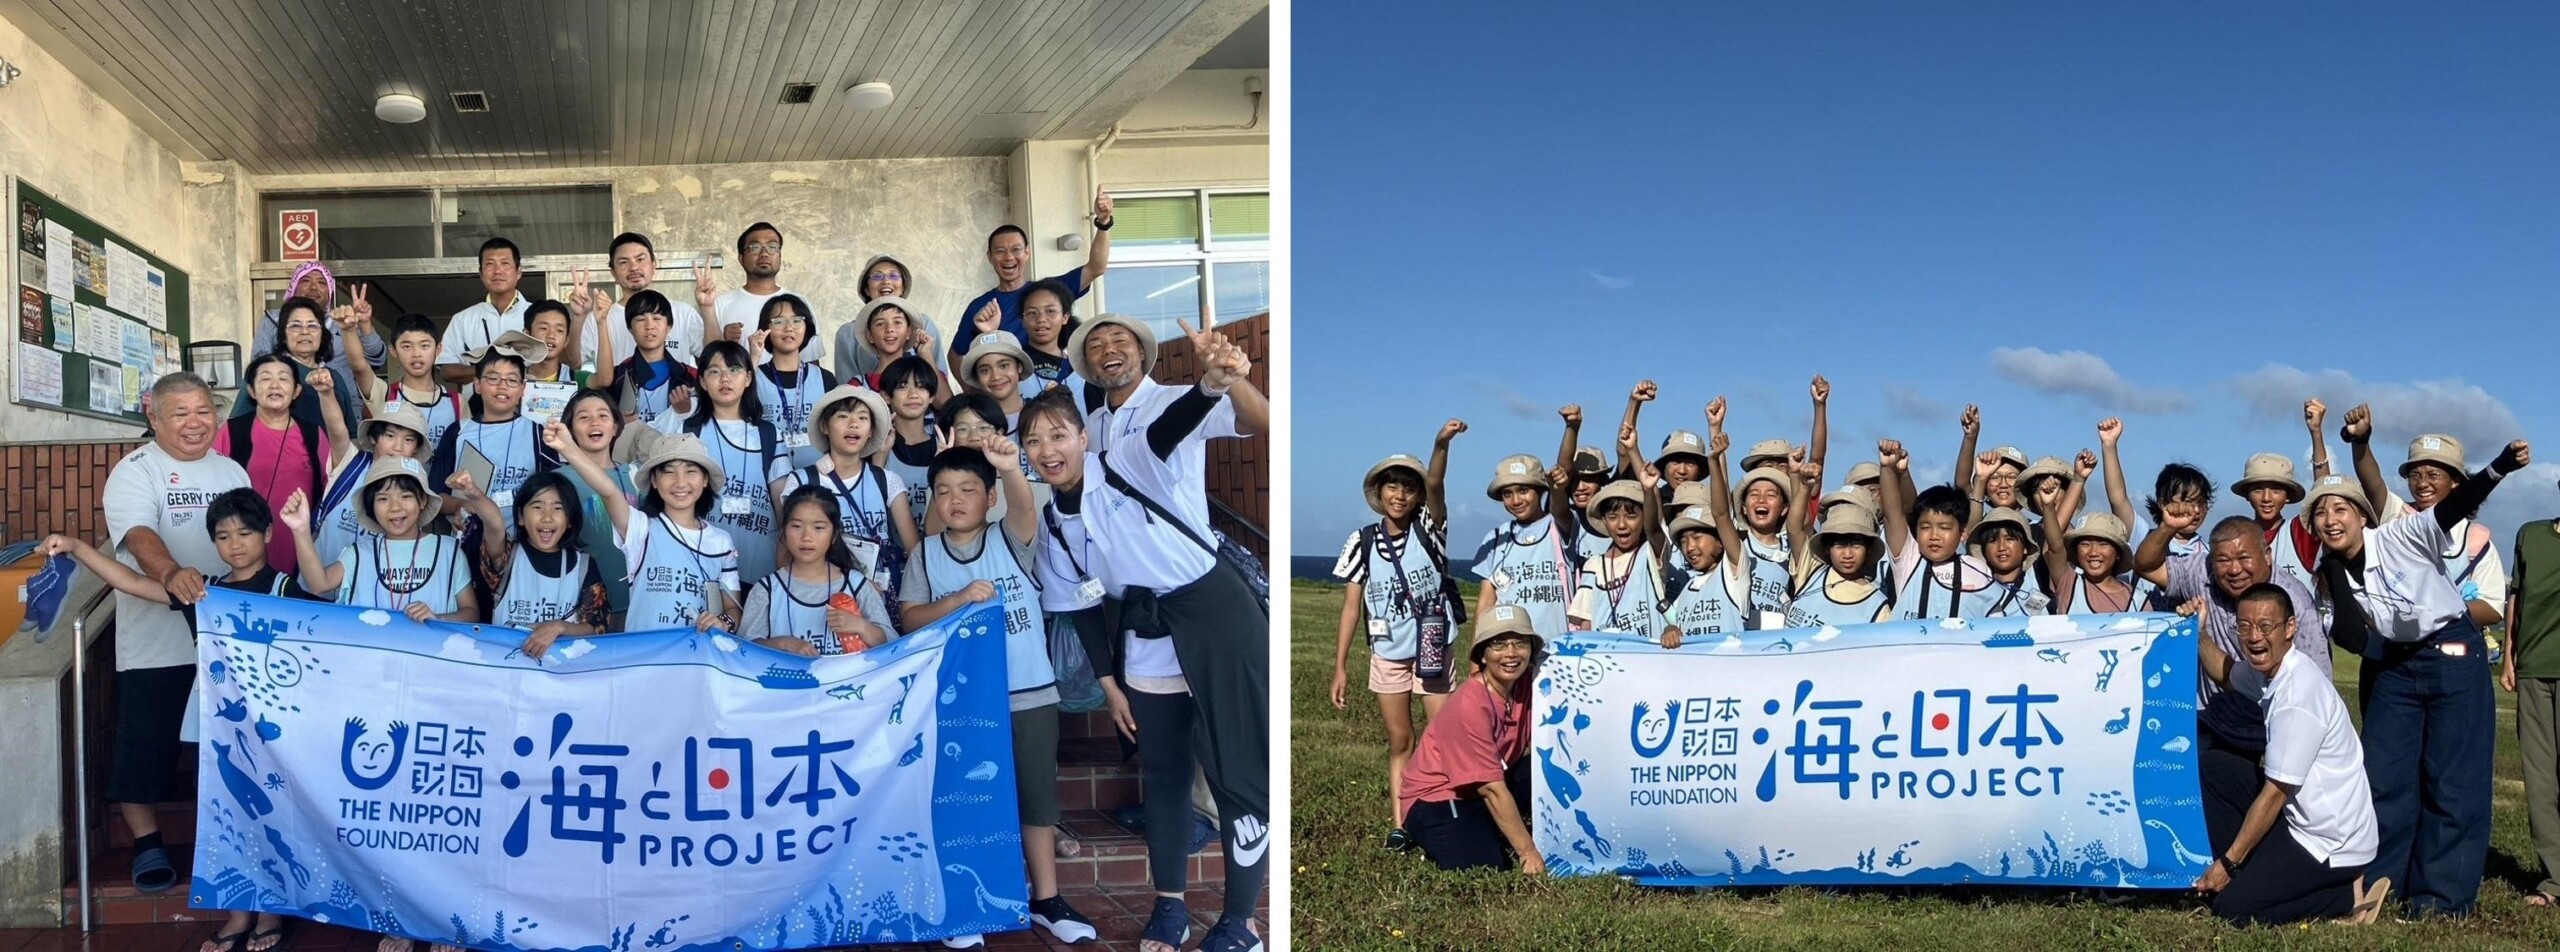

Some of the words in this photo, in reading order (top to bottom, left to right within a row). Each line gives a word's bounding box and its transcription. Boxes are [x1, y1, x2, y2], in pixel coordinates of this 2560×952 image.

[167, 493, 202, 506] GERRY
[380, 568, 411, 580] WAYS
[1515, 585, 1565, 604] 沖縄県
[658, 613, 669, 623] in
[1685, 698, 1741, 722] 日本
[415, 722, 486, 757] 日本
[1683, 728, 1738, 757] 財団
[1753, 680, 2065, 803] 海と日本
[411, 761, 483, 798] 財団
[500, 712, 862, 864] 海と日本
[1630, 767, 1661, 784] THE
[1667, 764, 1737, 783] NIPPON
[1872, 767, 2065, 800] PROJECT
[1630, 788, 1737, 807] FOUNDATION
[339, 799, 381, 822] THE
[389, 802, 481, 828] NIPPON
[337, 827, 480, 855] FOUNDATION
[640, 817, 858, 867] PROJECT
[1233, 814, 1267, 846] NI
